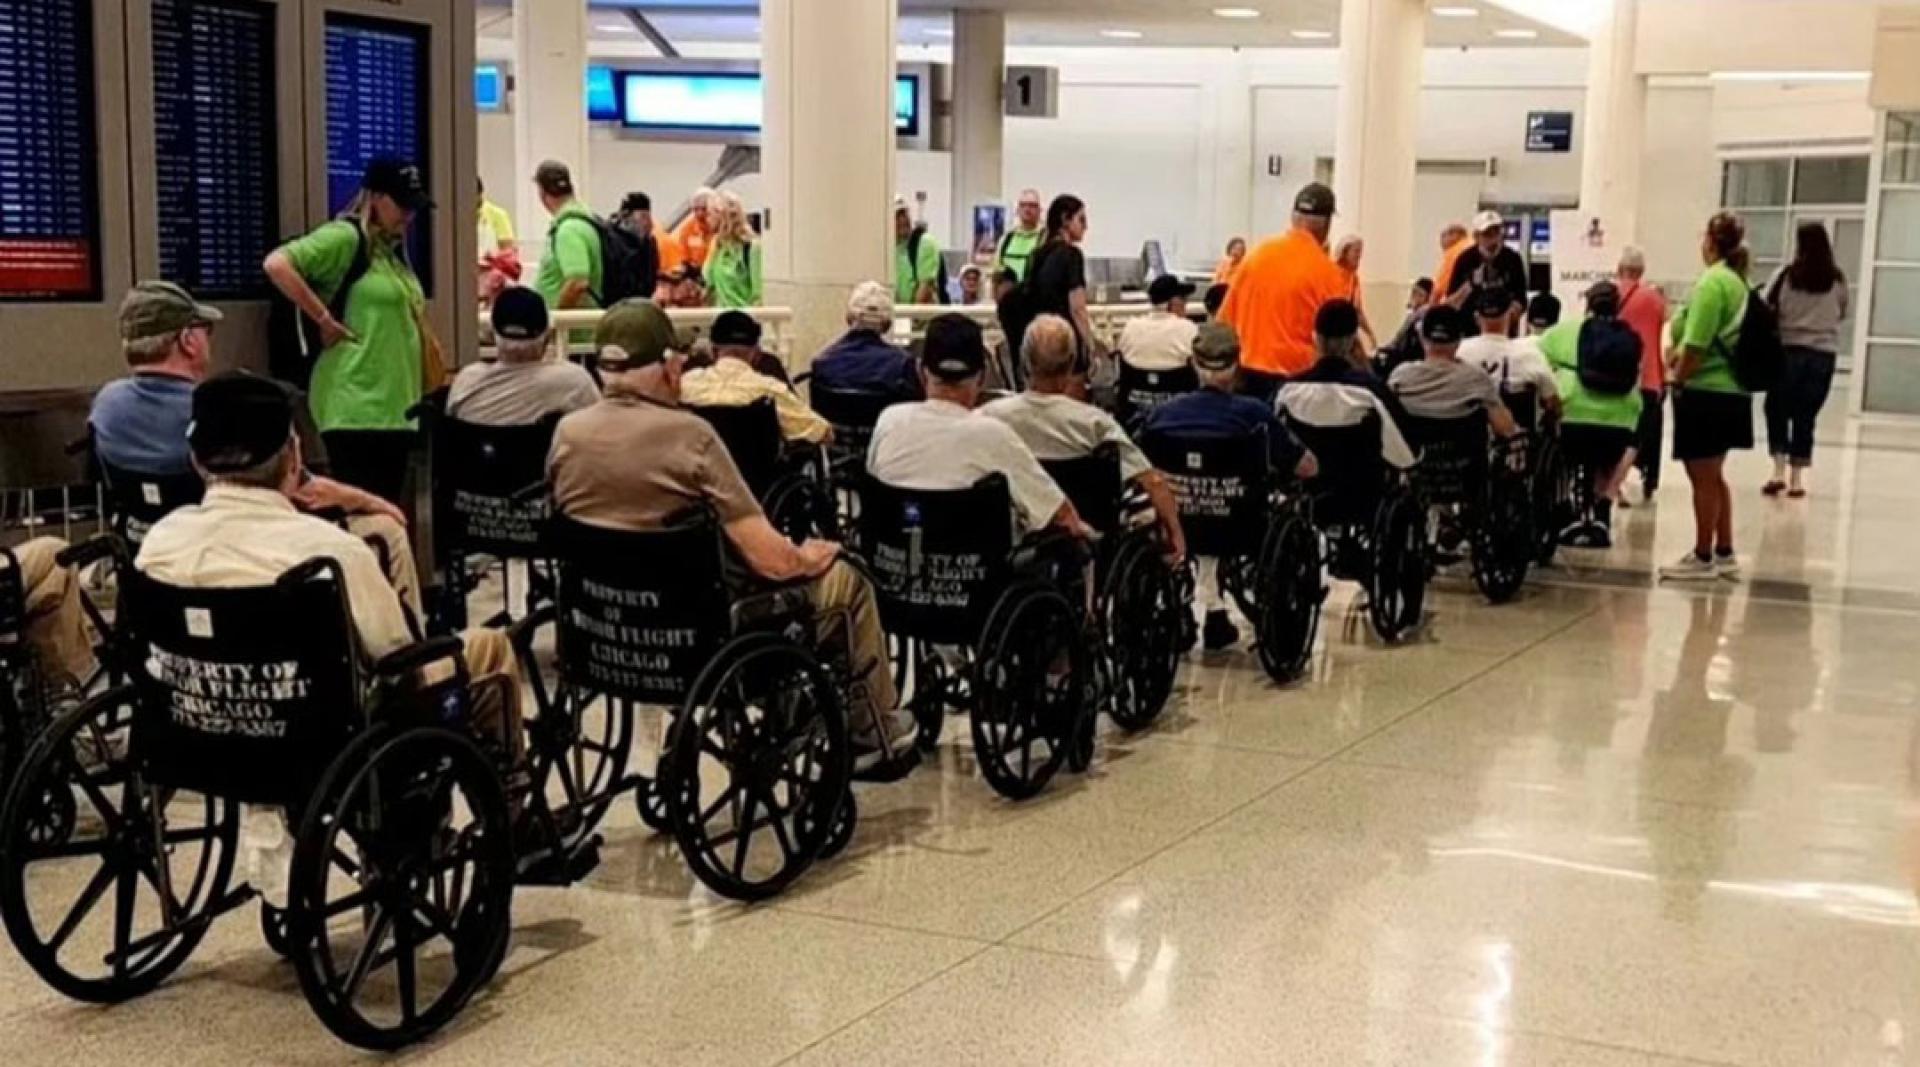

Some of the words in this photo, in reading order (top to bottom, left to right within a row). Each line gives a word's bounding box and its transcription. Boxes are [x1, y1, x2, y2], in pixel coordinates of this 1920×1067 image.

[1017, 75, 1031, 107] 1
[620, 626, 696, 646] FLIGHT
[262, 661, 299, 679] OF
[172, 691, 272, 719] CHICAGO
